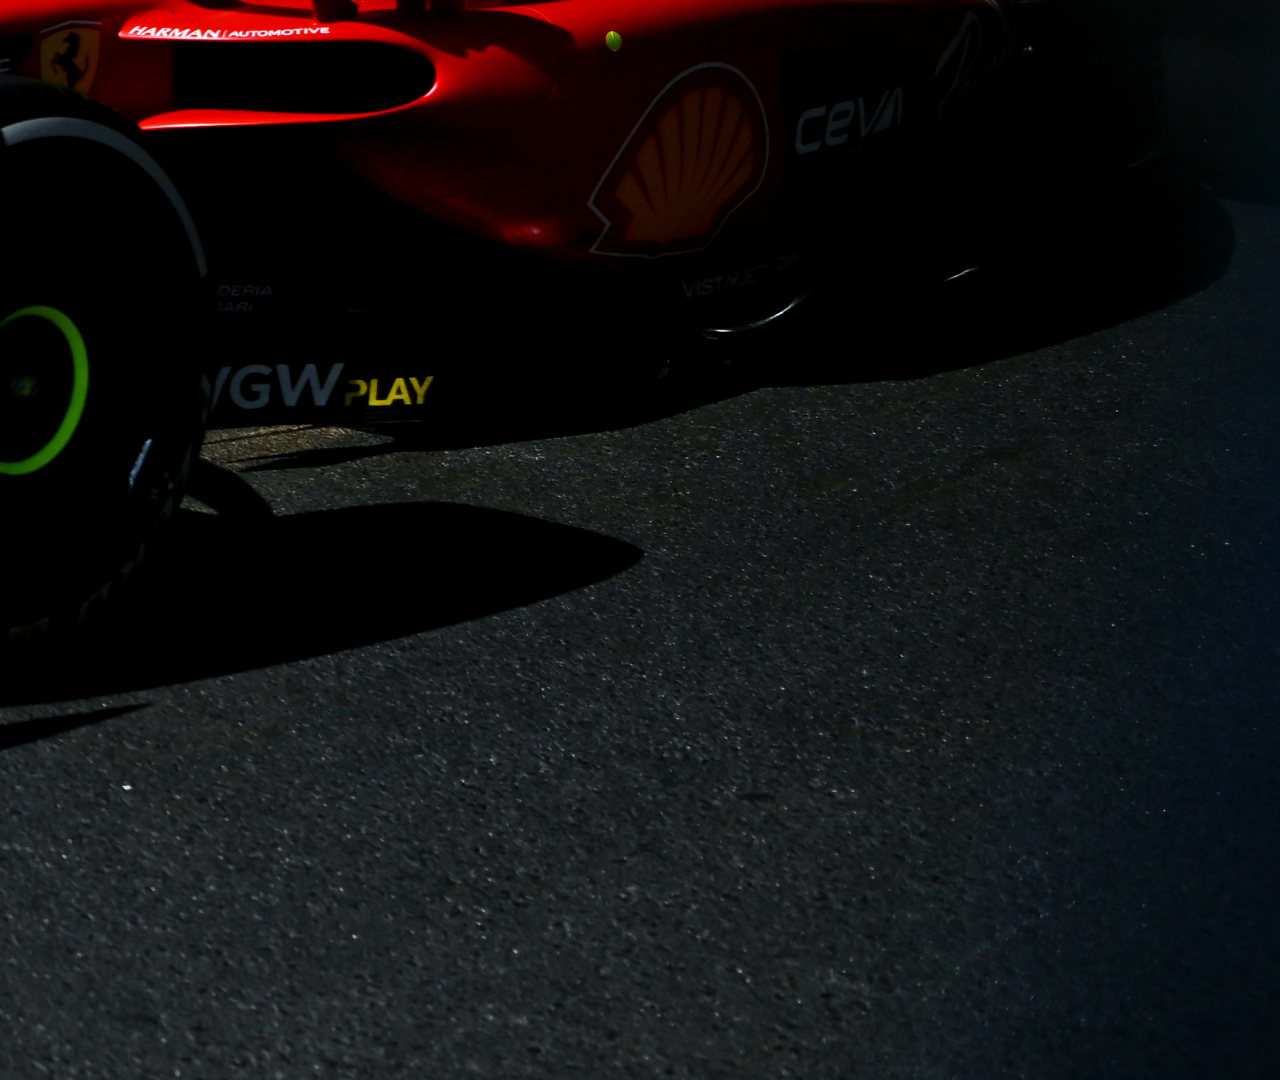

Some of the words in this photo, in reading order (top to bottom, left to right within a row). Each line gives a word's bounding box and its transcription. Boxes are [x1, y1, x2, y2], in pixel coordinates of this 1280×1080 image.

[128, 25, 221, 38] HARMAN
[227, 26, 331, 39] AUTOMOTIVE
[216, 283, 274, 297] DERIA
[344, 375, 436, 408] PLAY
